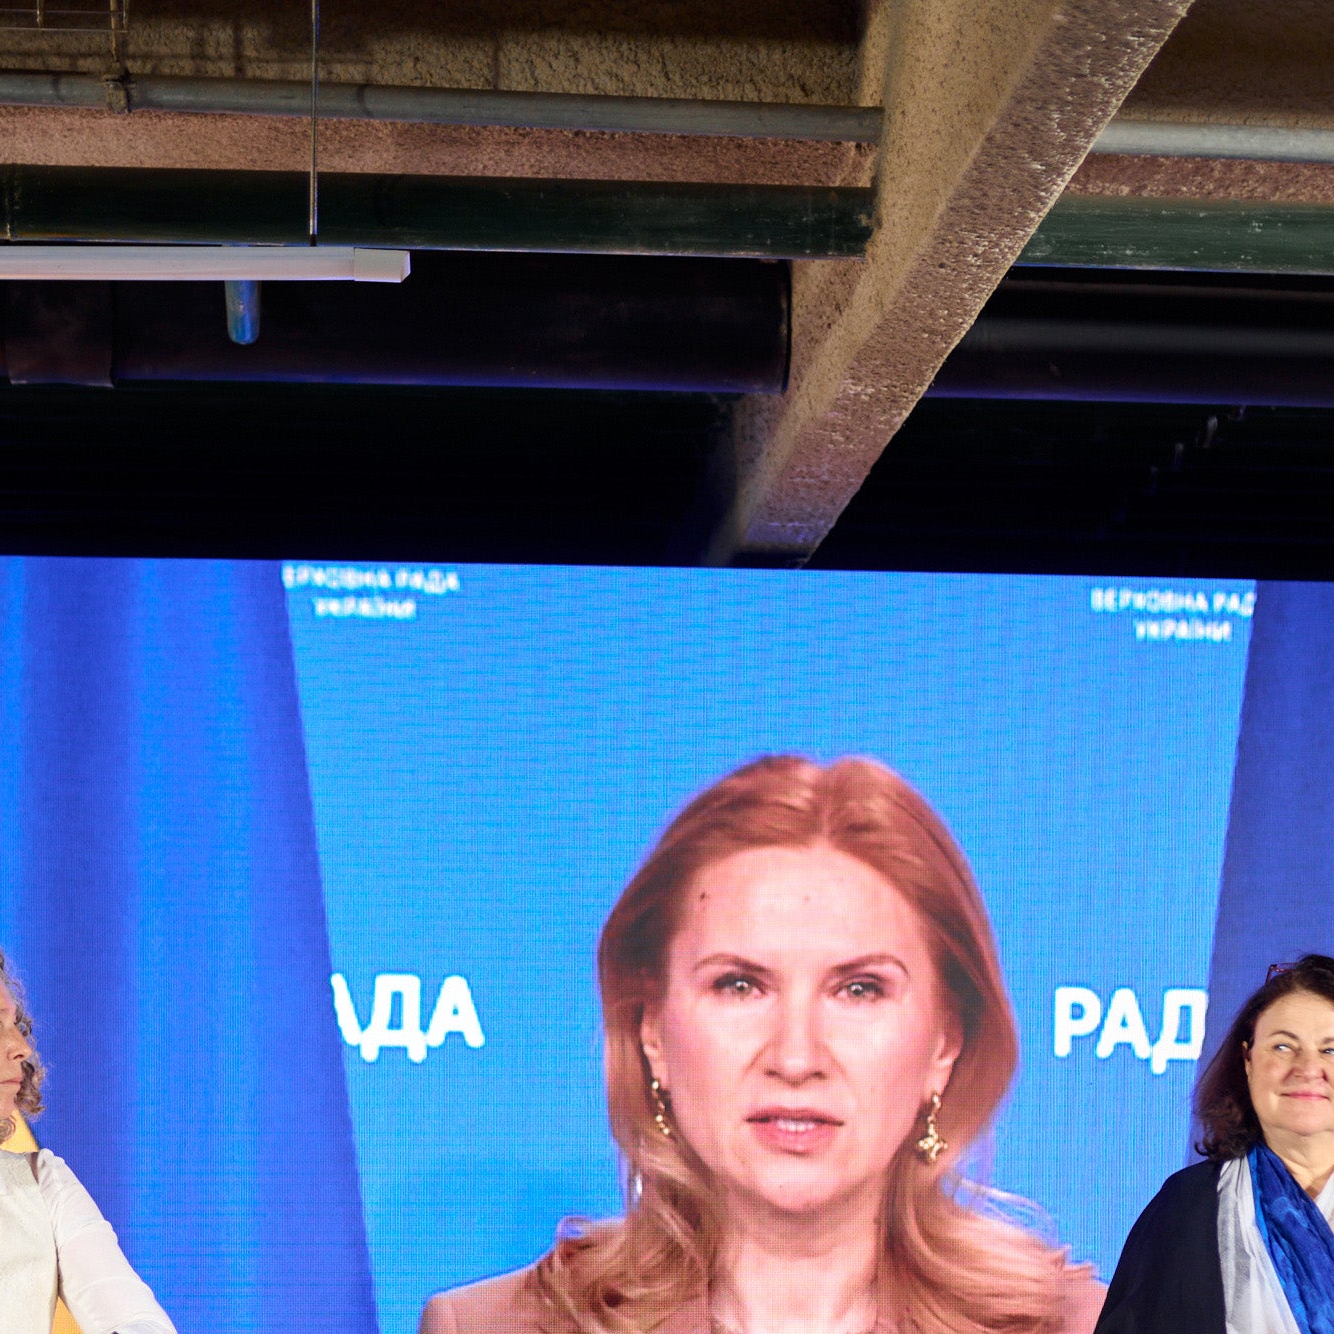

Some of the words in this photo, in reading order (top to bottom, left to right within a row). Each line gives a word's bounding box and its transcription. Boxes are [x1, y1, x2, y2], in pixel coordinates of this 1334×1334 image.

[395, 569, 460, 594] РАДА
[315, 597, 416, 618] УКРАЇНИ
[1091, 587, 1208, 612] ВЕРХОВНА
[1135, 618, 1231, 641] УКРАЇНИ
[1054, 986, 1208, 1075] РАД
